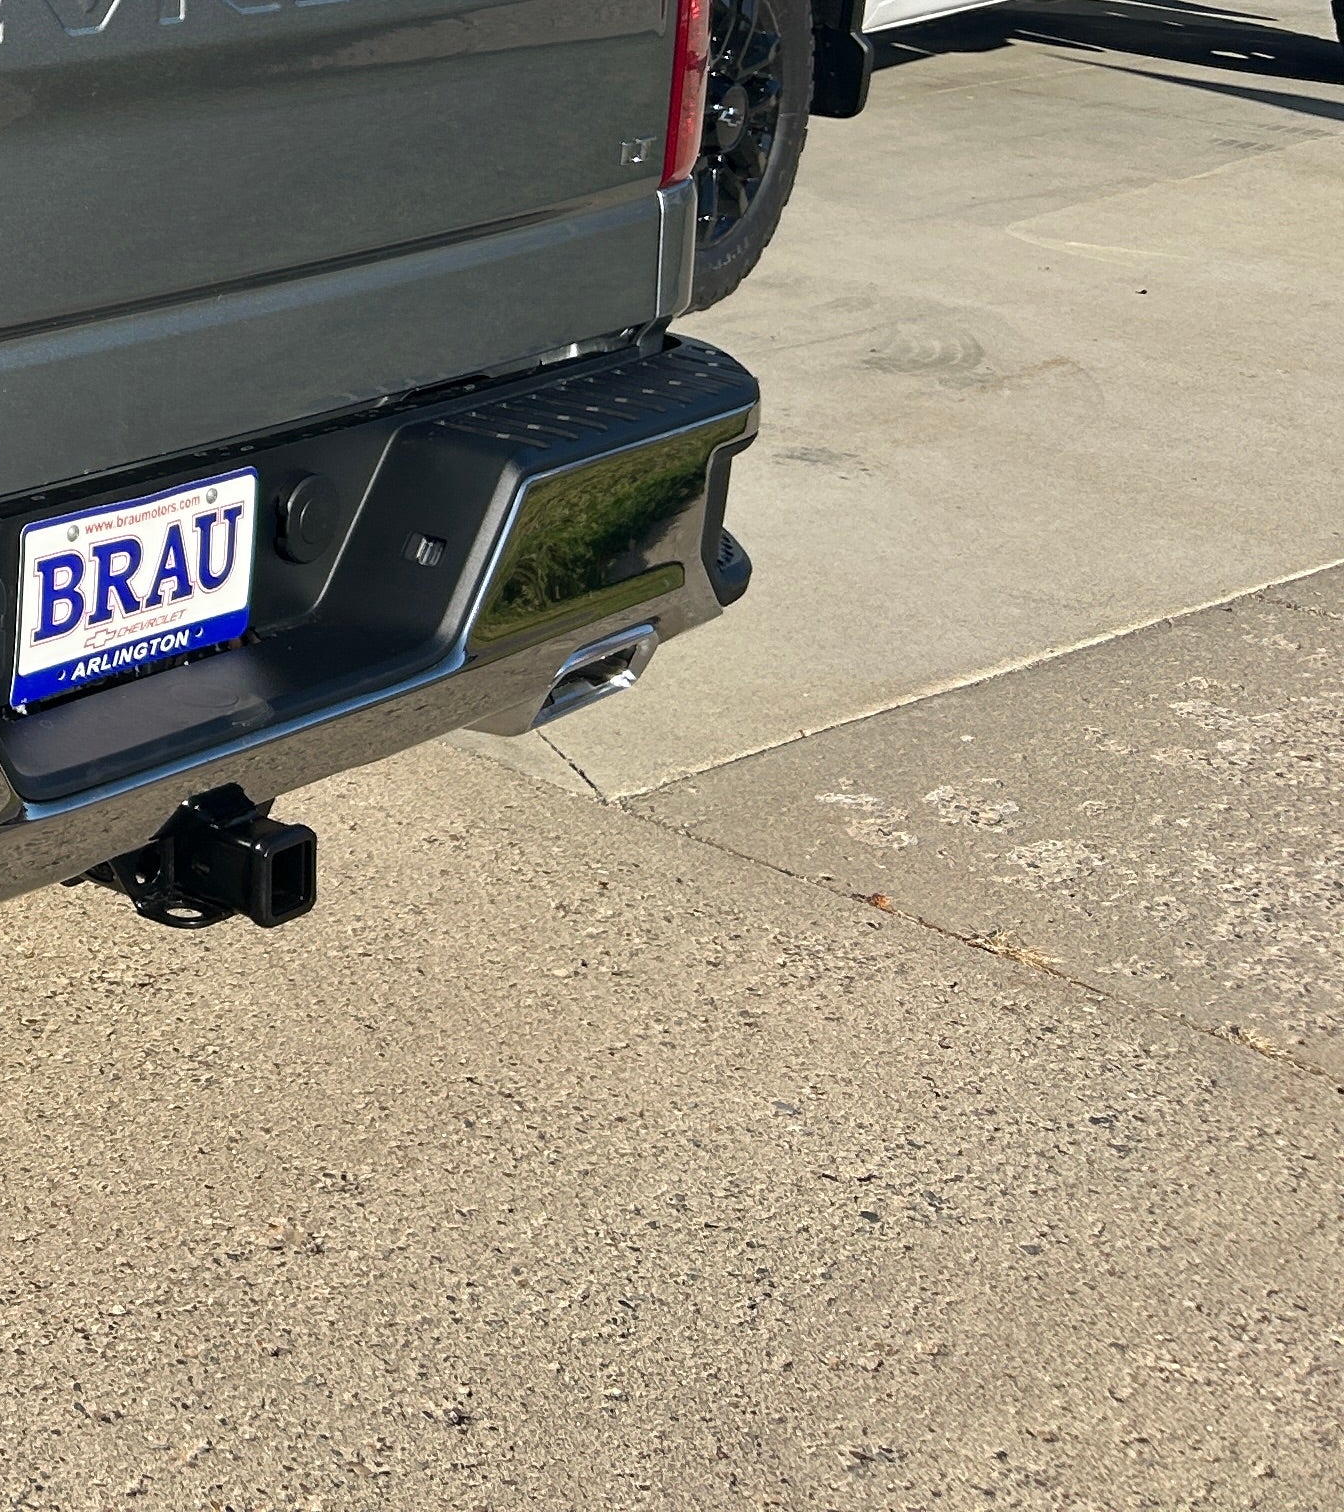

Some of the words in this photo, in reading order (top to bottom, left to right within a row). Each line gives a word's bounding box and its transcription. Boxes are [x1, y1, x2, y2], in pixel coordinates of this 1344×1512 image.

[84, 495, 201, 535] www.braumotors.com
[31, 502, 244, 645] BRAU
[117, 609, 187, 639] CHEVROLET
[70, 628, 190, 682] ARLINGTON
